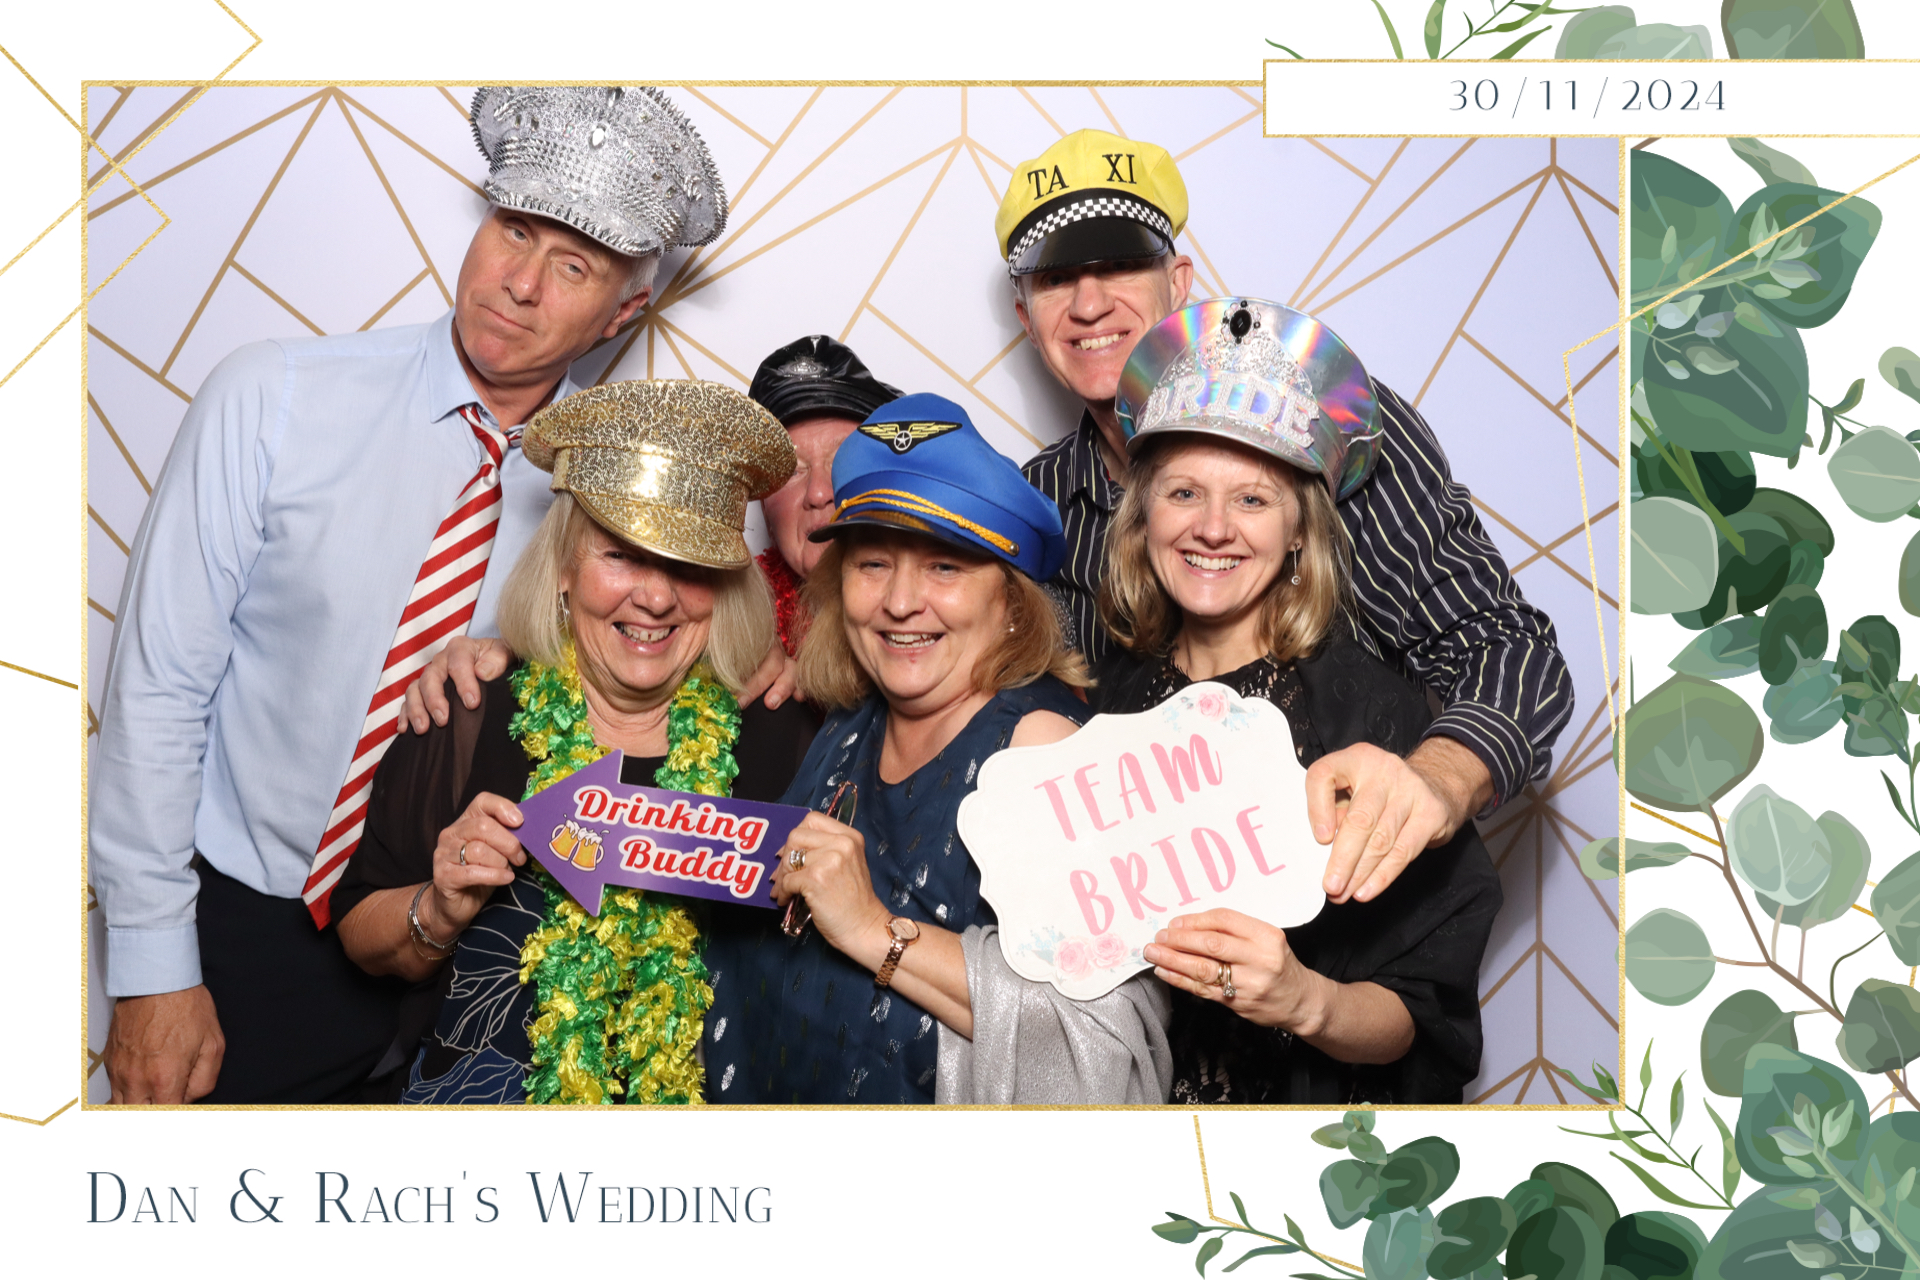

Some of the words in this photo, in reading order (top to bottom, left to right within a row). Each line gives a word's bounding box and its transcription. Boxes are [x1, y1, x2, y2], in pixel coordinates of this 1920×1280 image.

[1135, 372, 1320, 449] BRIDE
[573, 785, 770, 854] Drinking
[1033, 733, 1223, 842] TEAM
[619, 835, 765, 898] Buddy
[1069, 804, 1286, 937] BRIDE
